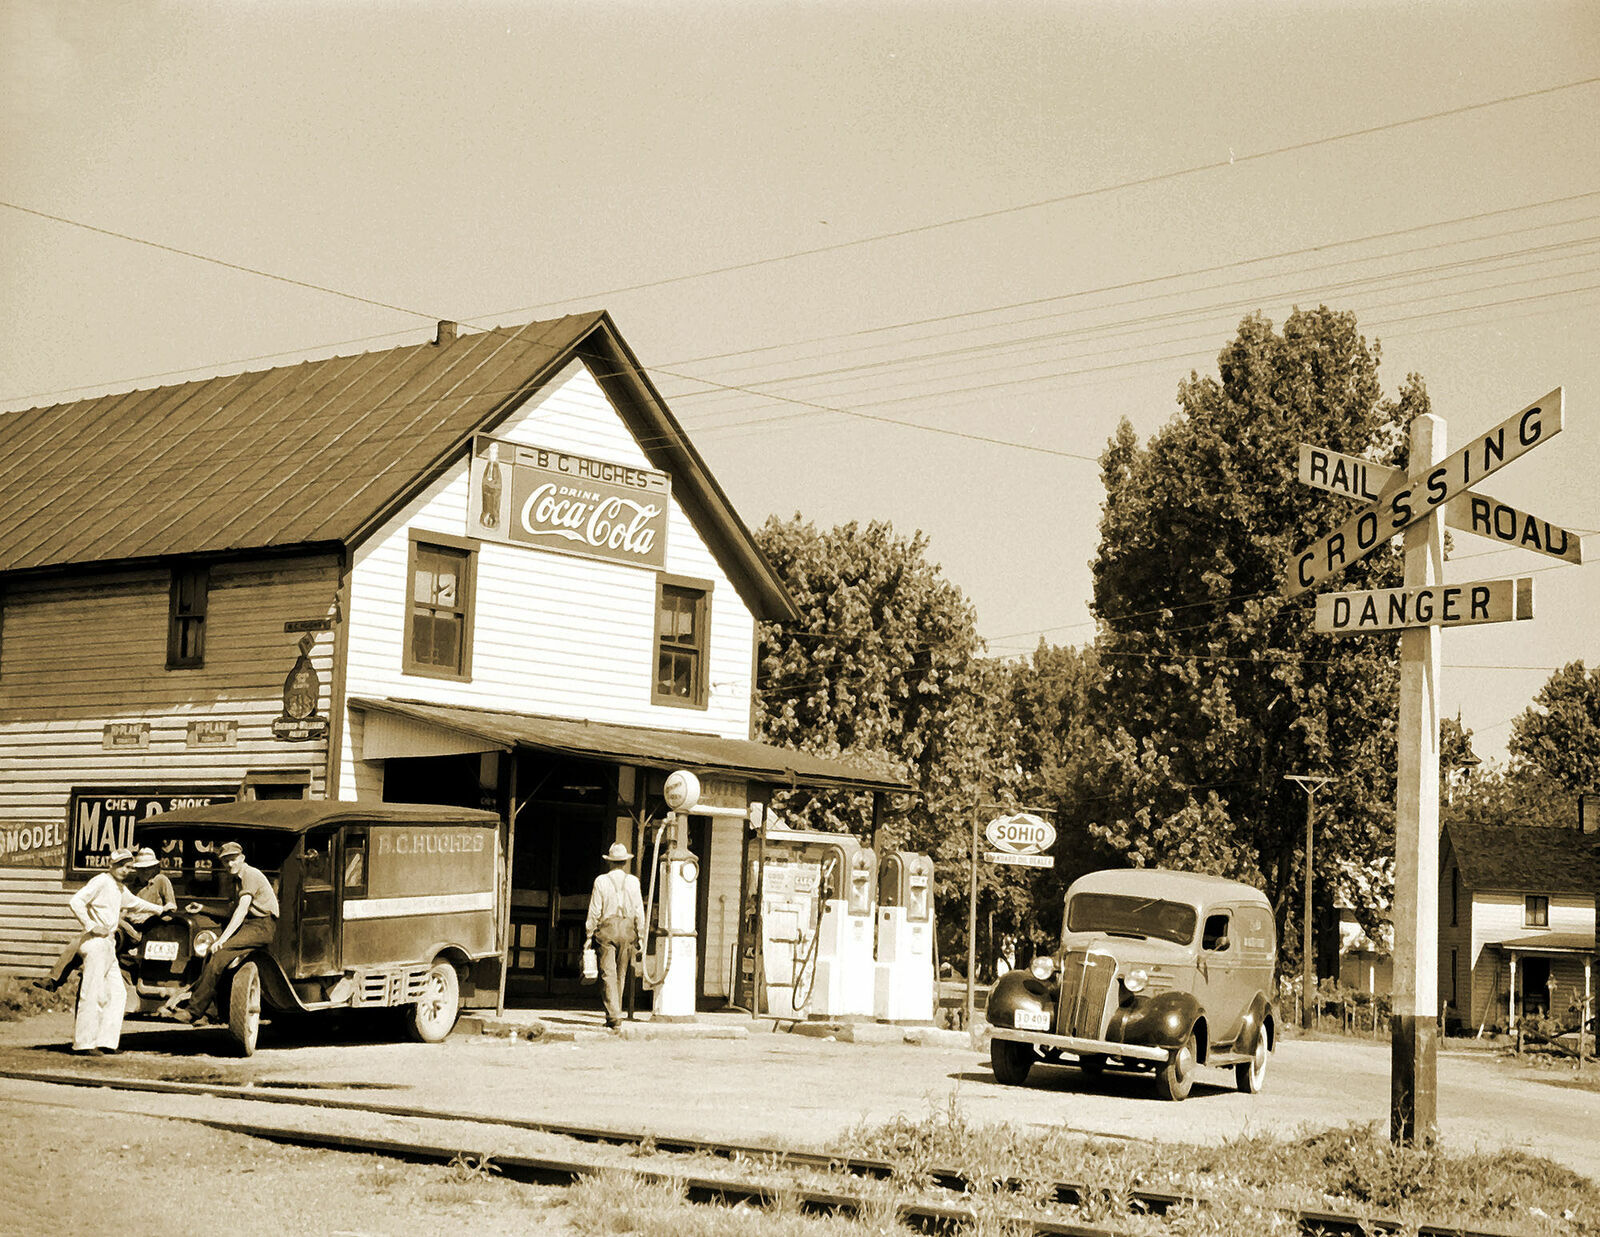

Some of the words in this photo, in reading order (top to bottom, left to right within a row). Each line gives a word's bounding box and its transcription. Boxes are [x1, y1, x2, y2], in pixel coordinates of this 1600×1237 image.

[537, 450, 549, 468] B
[557, 454, 570, 472] C
[578, 454, 648, 488] HUGHES
[559, 485, 601, 502] DRINK
[1298, 406, 1543, 588] CROSSING
[1310, 450, 1379, 501] RAIL
[1471, 497, 1568, 555] ROAD
[521, 482, 662, 554] Coca-Cola
[1333, 586, 1491, 628] DANGER
[105, 799, 138, 811] CHEW
[7, 823, 63, 853] MODEL
[78, 801, 140, 852] MAIL
[996, 824, 1046, 843] SOHIO
